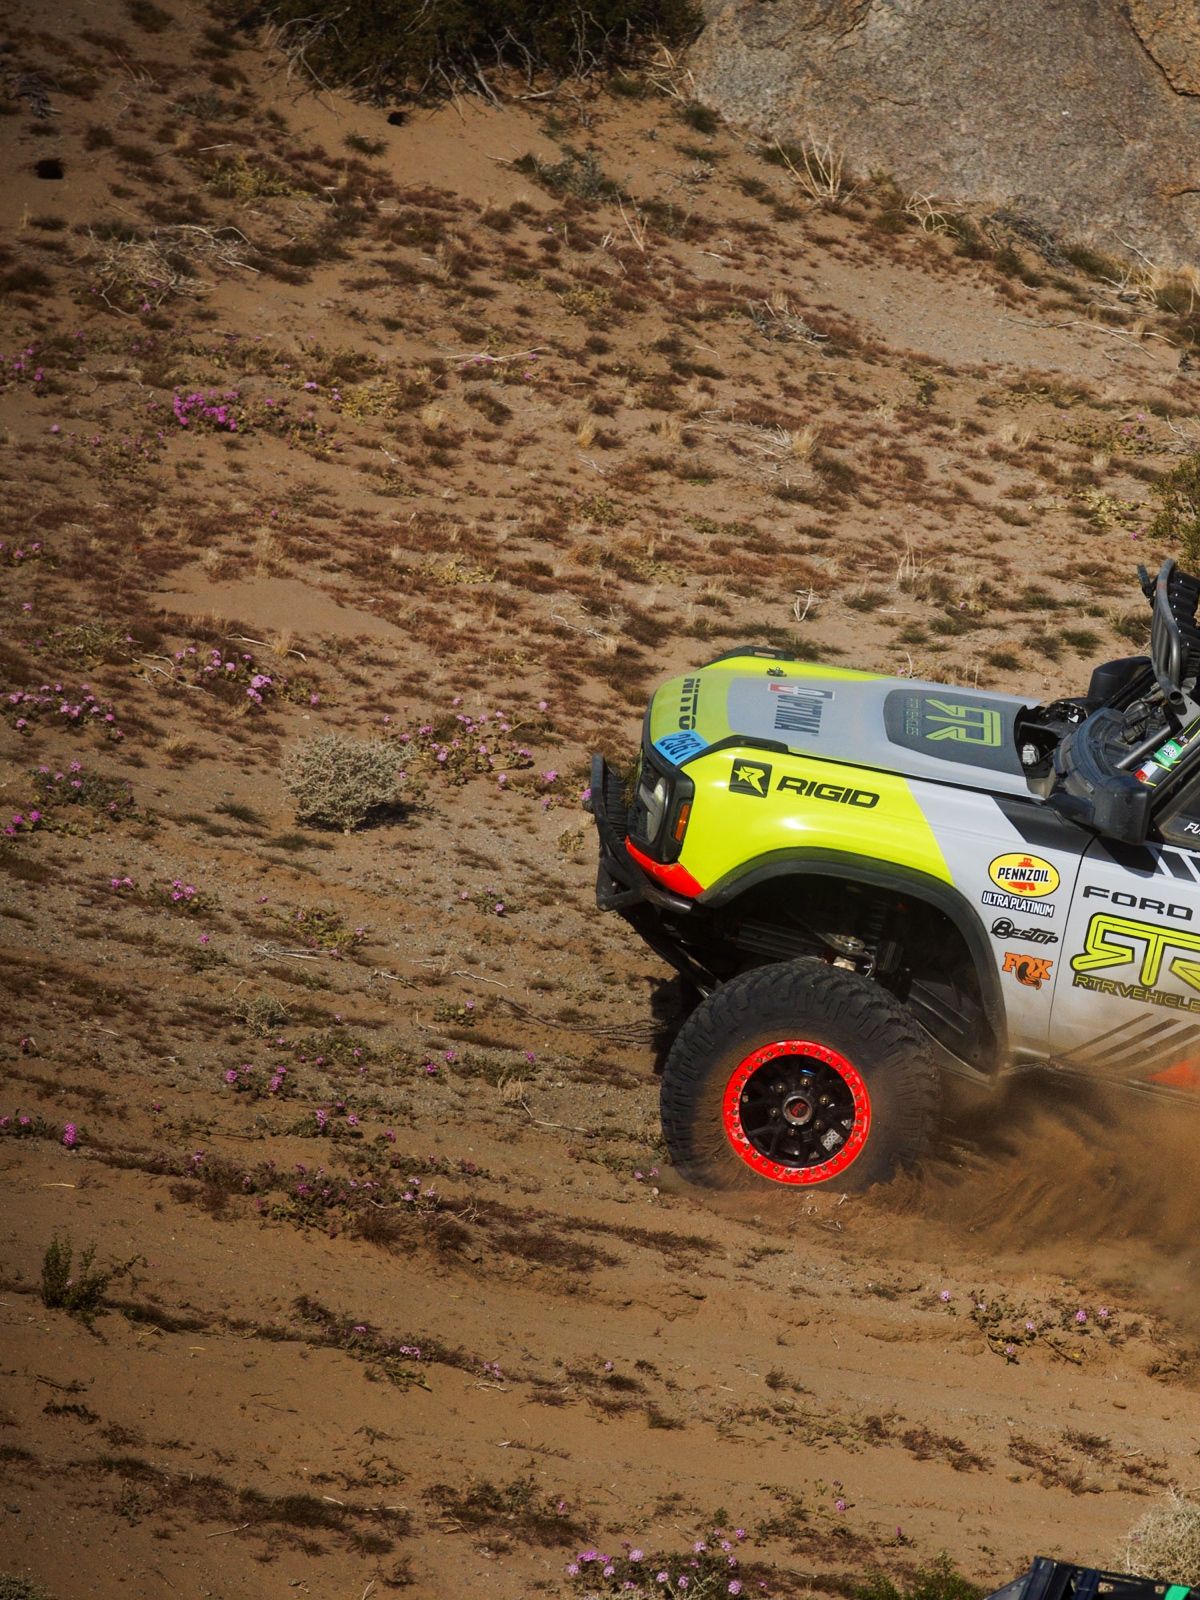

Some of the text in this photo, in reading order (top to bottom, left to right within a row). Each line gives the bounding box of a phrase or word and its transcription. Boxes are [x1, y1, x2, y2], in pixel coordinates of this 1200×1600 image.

[678, 678, 701, 730] NITTO
[774, 694, 823, 734] OPTIMA
[776, 776, 881, 809] RIGID
[997, 867, 1049, 883] PENNZOIL
[982, 891, 1055, 917] ULTRA PLATINUM
[1082, 885, 1194, 922] FORD
[1002, 952, 1054, 984] FOX
[1074, 974, 1116, 995] RTR
